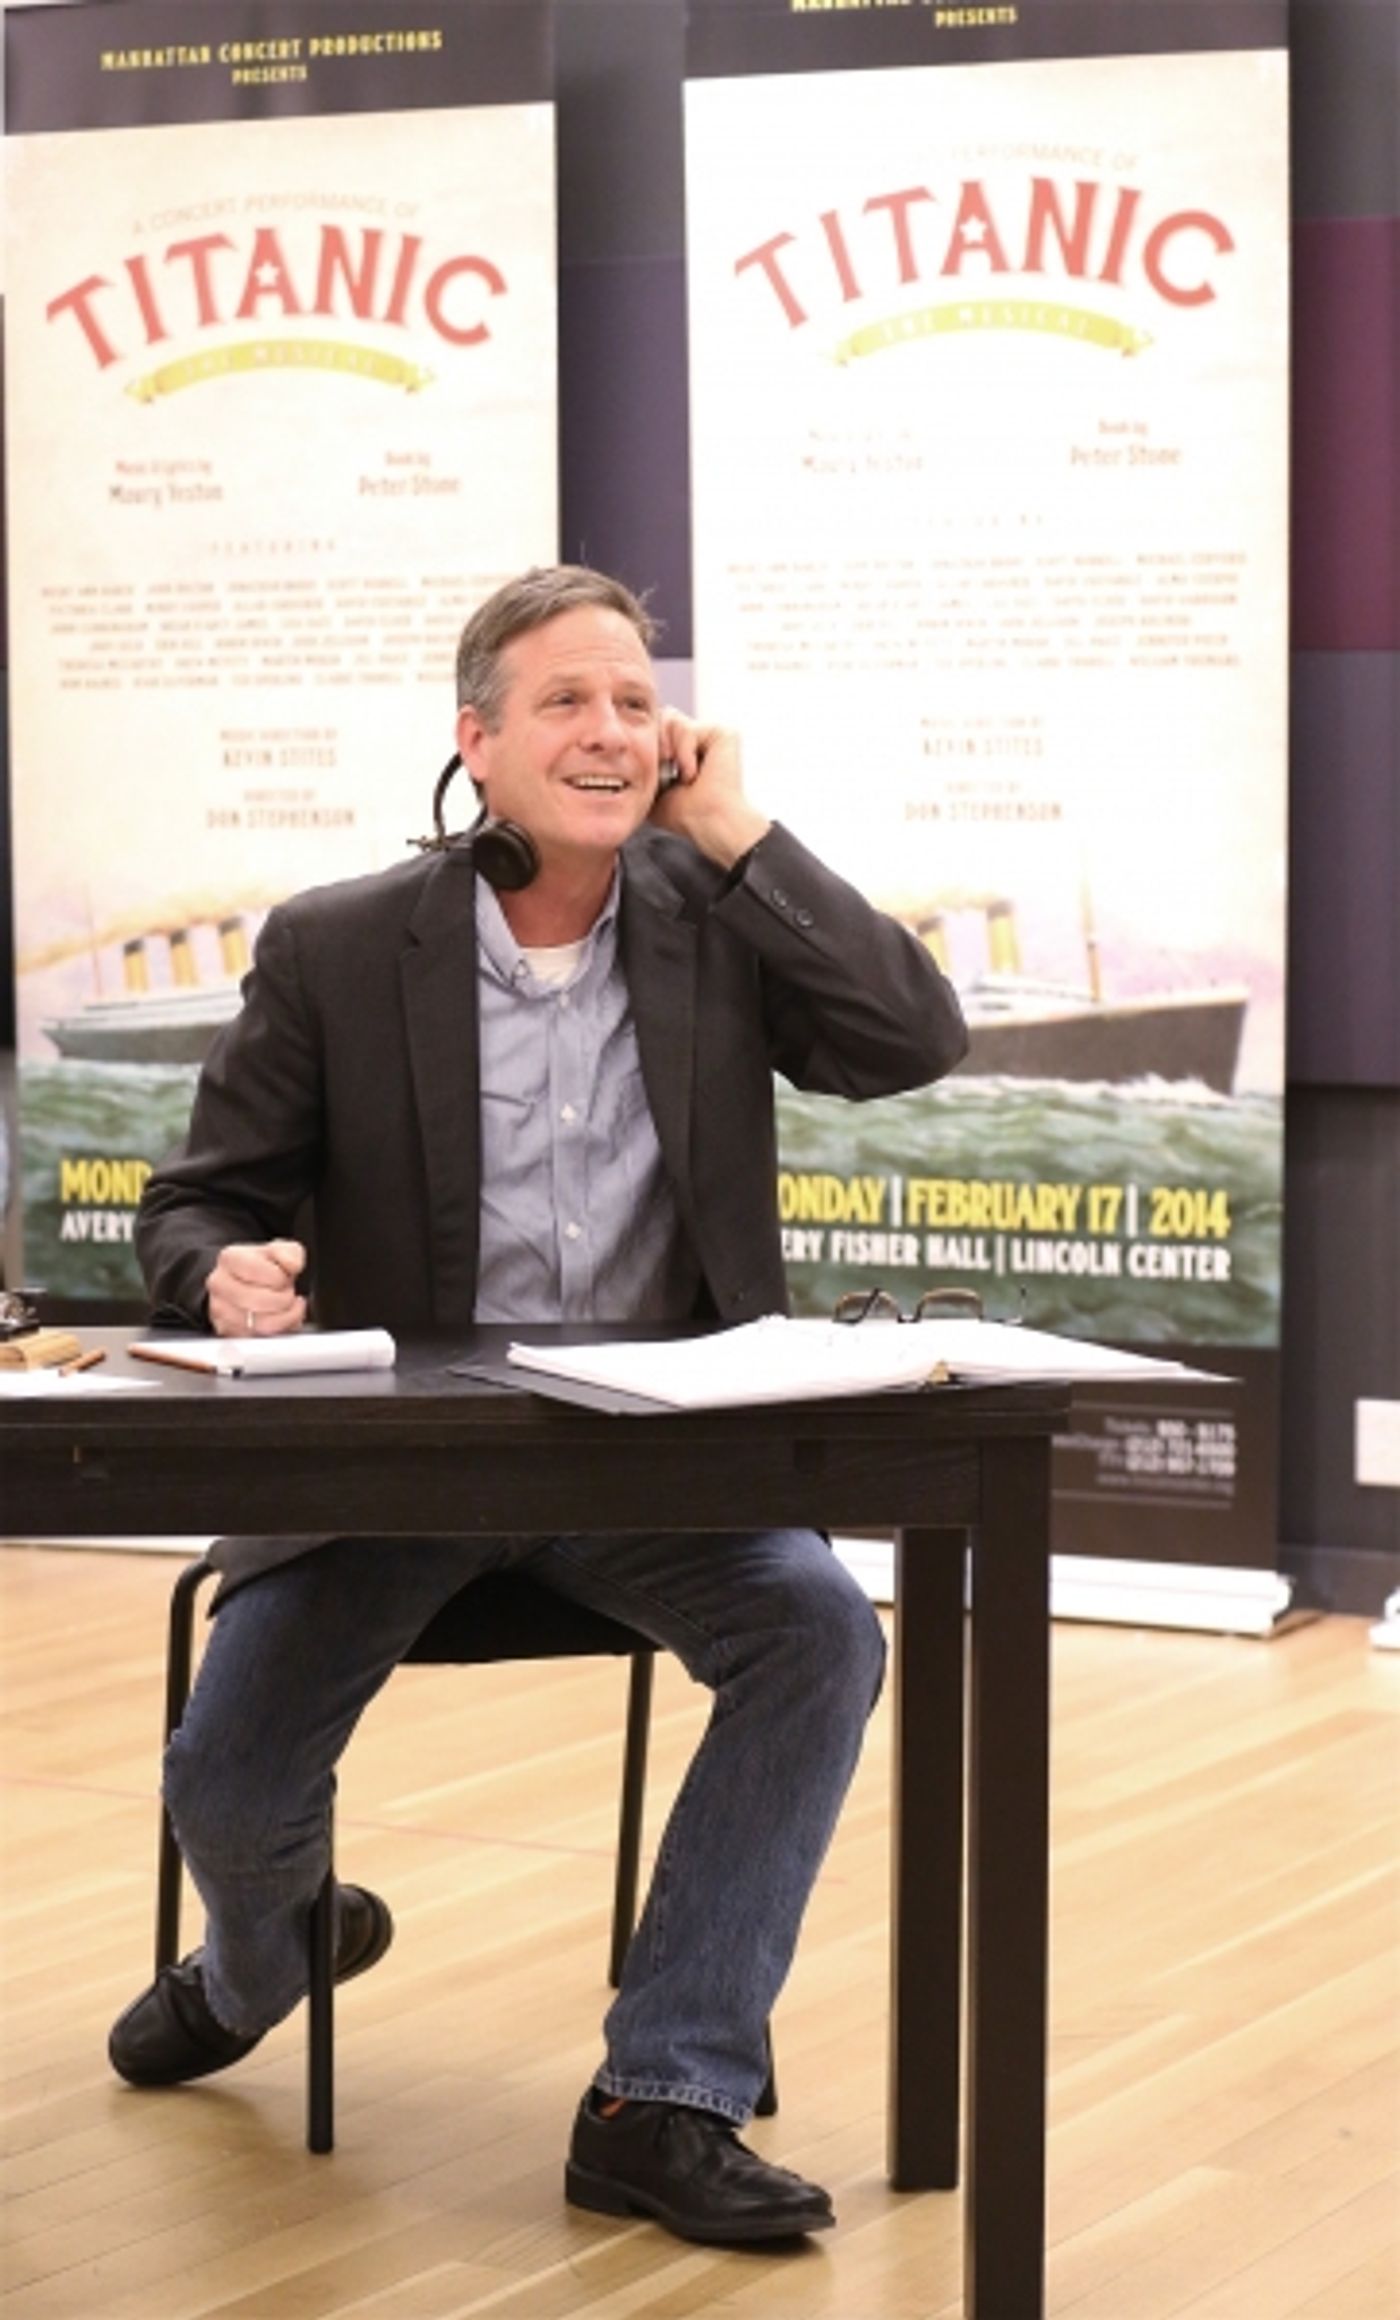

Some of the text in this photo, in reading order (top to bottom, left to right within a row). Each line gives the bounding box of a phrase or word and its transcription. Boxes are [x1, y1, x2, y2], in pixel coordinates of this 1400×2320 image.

[101, 30, 442, 70] MANHATTAN CONCERT PRODUCTIONS
[232, 64, 307, 86] PRESENTS
[735, 176, 1236, 329] TITANIC
[46, 223, 508, 371] TITANIC
[60, 1209, 136, 1243] AVERY
[907, 1177, 1082, 1234] FEBRUARY
[1087, 1185, 1123, 1235] 17
[1148, 1186, 1231, 1239] 2014
[830, 1229, 919, 1268] FISHER
[925, 1233, 991, 1271] HALL
[1011, 1237, 1120, 1277] LINCOLN
[1126, 1243, 1231, 1282] CENTER
